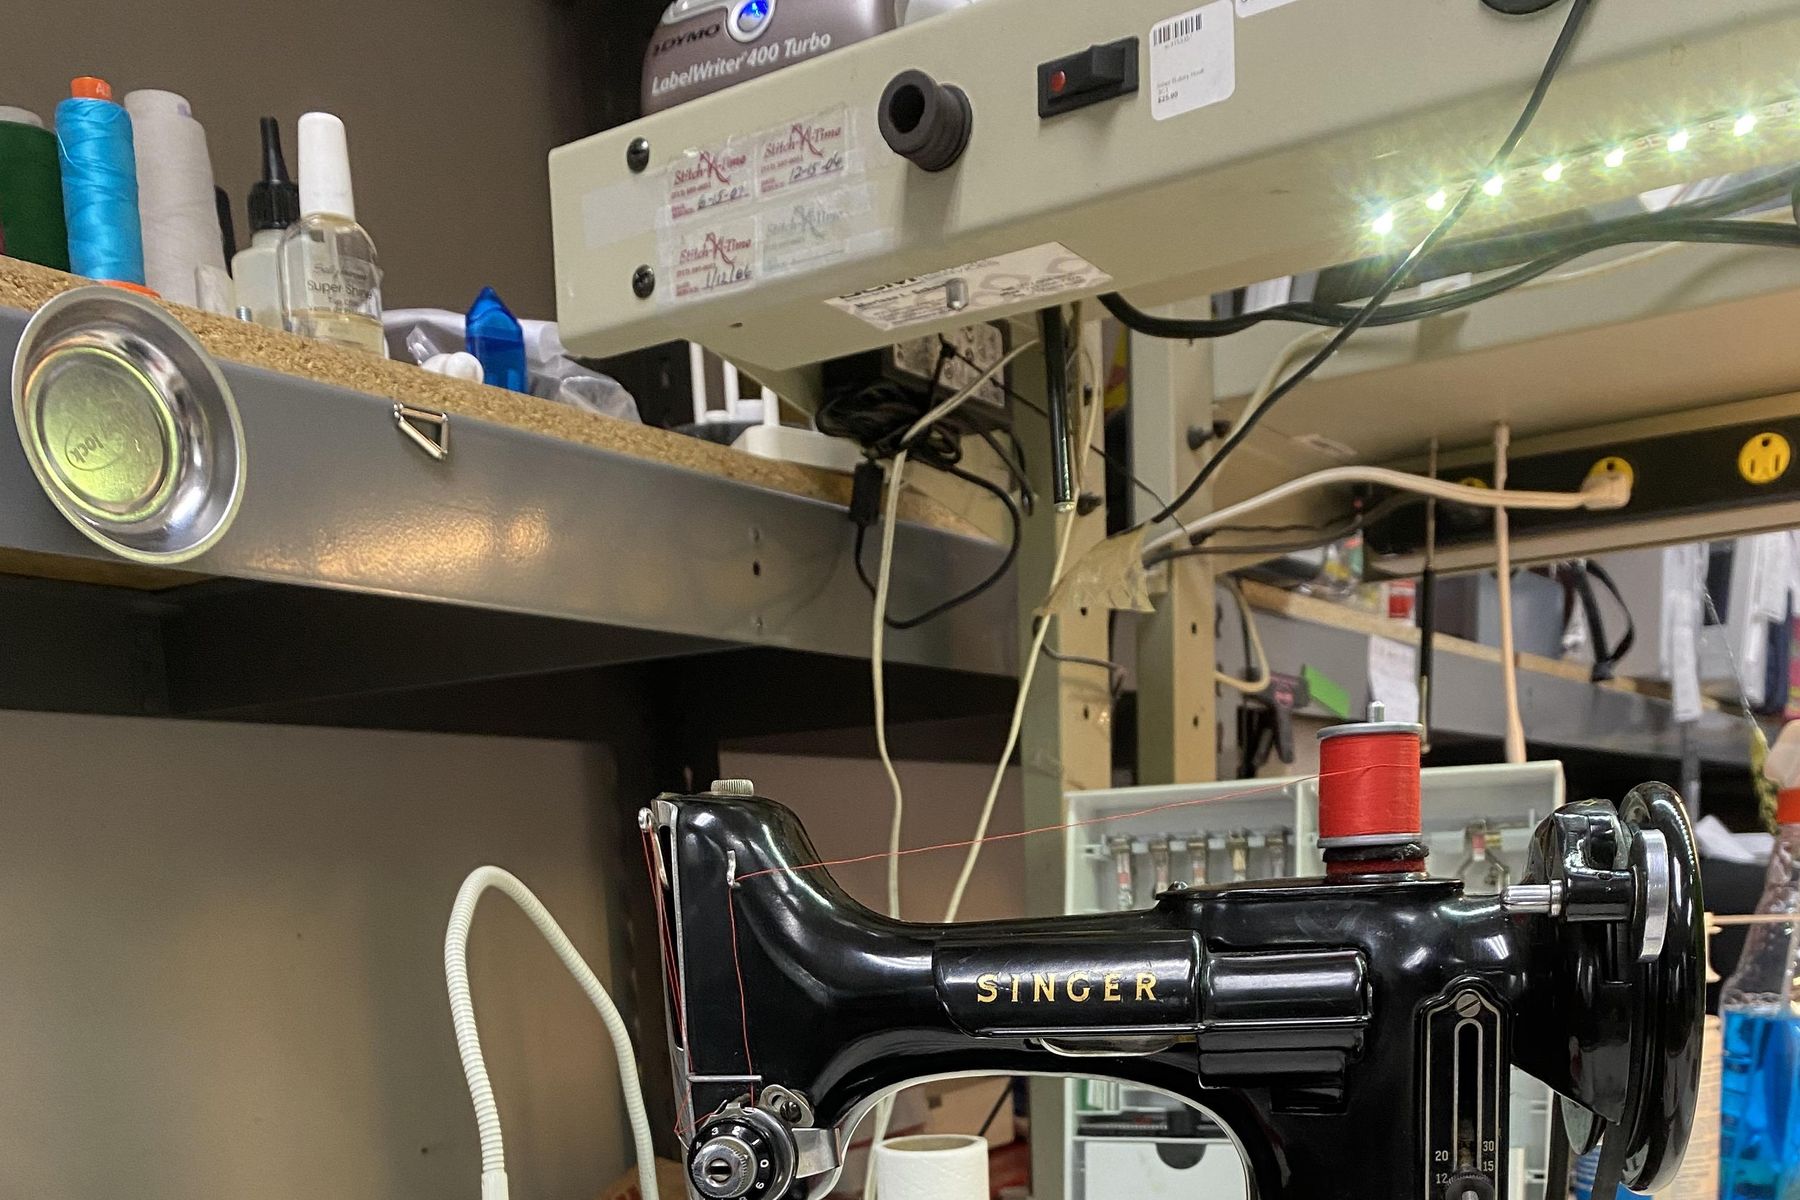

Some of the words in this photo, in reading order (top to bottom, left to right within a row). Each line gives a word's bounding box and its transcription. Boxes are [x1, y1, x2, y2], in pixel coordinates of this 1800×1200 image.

[651, 54, 745, 96] LabelWriter
[747, 43, 780, 67] 400
[784, 31, 831, 58] Turbo
[307, 280, 341, 294] Super
[976, 970, 1158, 1004] SINGER
[711, 1126, 720, 1136] 3
[731, 1125, 742, 1136] 2
[760, 1159, 770, 1168] 0
[1482, 1140, 1495, 1152] 30
[1434, 1150, 1449, 1162] 20
[1482, 1160, 1494, 1172] 15
[1435, 1172, 1448, 1184] 12
